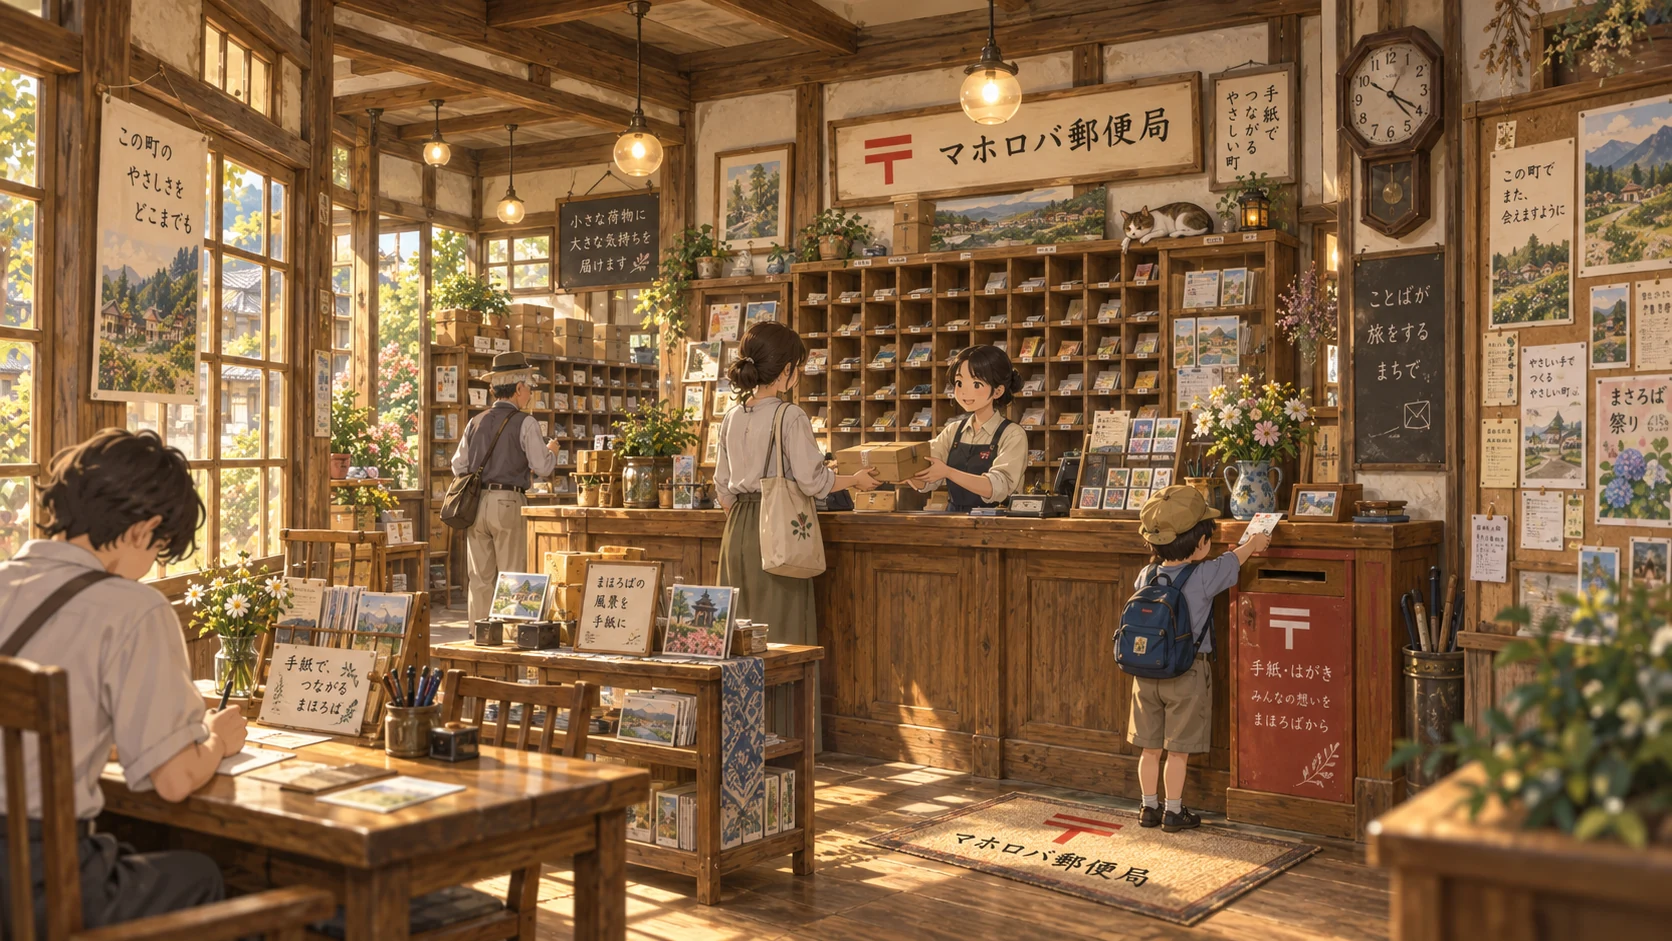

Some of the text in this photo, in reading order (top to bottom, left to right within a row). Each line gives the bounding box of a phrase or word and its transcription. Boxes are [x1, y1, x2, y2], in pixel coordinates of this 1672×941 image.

[1371, 59, 1379, 71] 11
[1386, 52, 1397, 65] 12
[1405, 53, 1410, 66] 1
[1416, 65, 1424, 78] 2
[1359, 75, 1370, 87] 10
[1420, 84, 1428, 96] 3
[1355, 94, 1363, 106] 9
[1263, 84, 1280, 141] 手紙で
[1360, 112, 1367, 124] 8
[1415, 105, 1423, 117] 4
[1226, 91, 1240, 171] やさしい町
[1245, 91, 1259, 155] つながる
[1371, 124, 1379, 136] 7
[1387, 126, 1395, 138] 6
[1404, 120, 1411, 132] 5
[119, 127, 172, 161] この町の
[939, 107, 1170, 165] マホロバ郵便局
[1503, 161, 1555, 183] この町で
[127, 165, 183, 199] やさしさを
[1503, 188, 1528, 203] また、
[135, 202, 191, 234] どこまでも
[570, 208, 646, 229] 小さな荷物に
[1501, 204, 1565, 225] 会えますように
[569, 231, 651, 252] 大きな気持ちを
[579, 256, 627, 274] 届けます
[1369, 285, 1431, 308] ことばが
[1367, 322, 1429, 345] 旅をする
[1377, 359, 1421, 381] まちで
[1529, 355, 1575, 368] やさしい手で
[1530, 372, 1553, 383] つくる
[1530, 386, 1570, 399] やさしい町
[1611, 385, 1667, 407] まさろば
[597, 576, 645, 589] まほろばの
[592, 614, 626, 629] 手紙に
[284, 654, 330, 674] 手紙で、
[1250, 659, 1332, 682] 手紙・はがき
[301, 679, 347, 696] つながる
[296, 698, 343, 715] まほろば
[1251, 690, 1331, 709] みんなの想いを
[1254, 712, 1329, 733] まほろばから
[955, 832, 1151, 888] マホロバ郵便局
